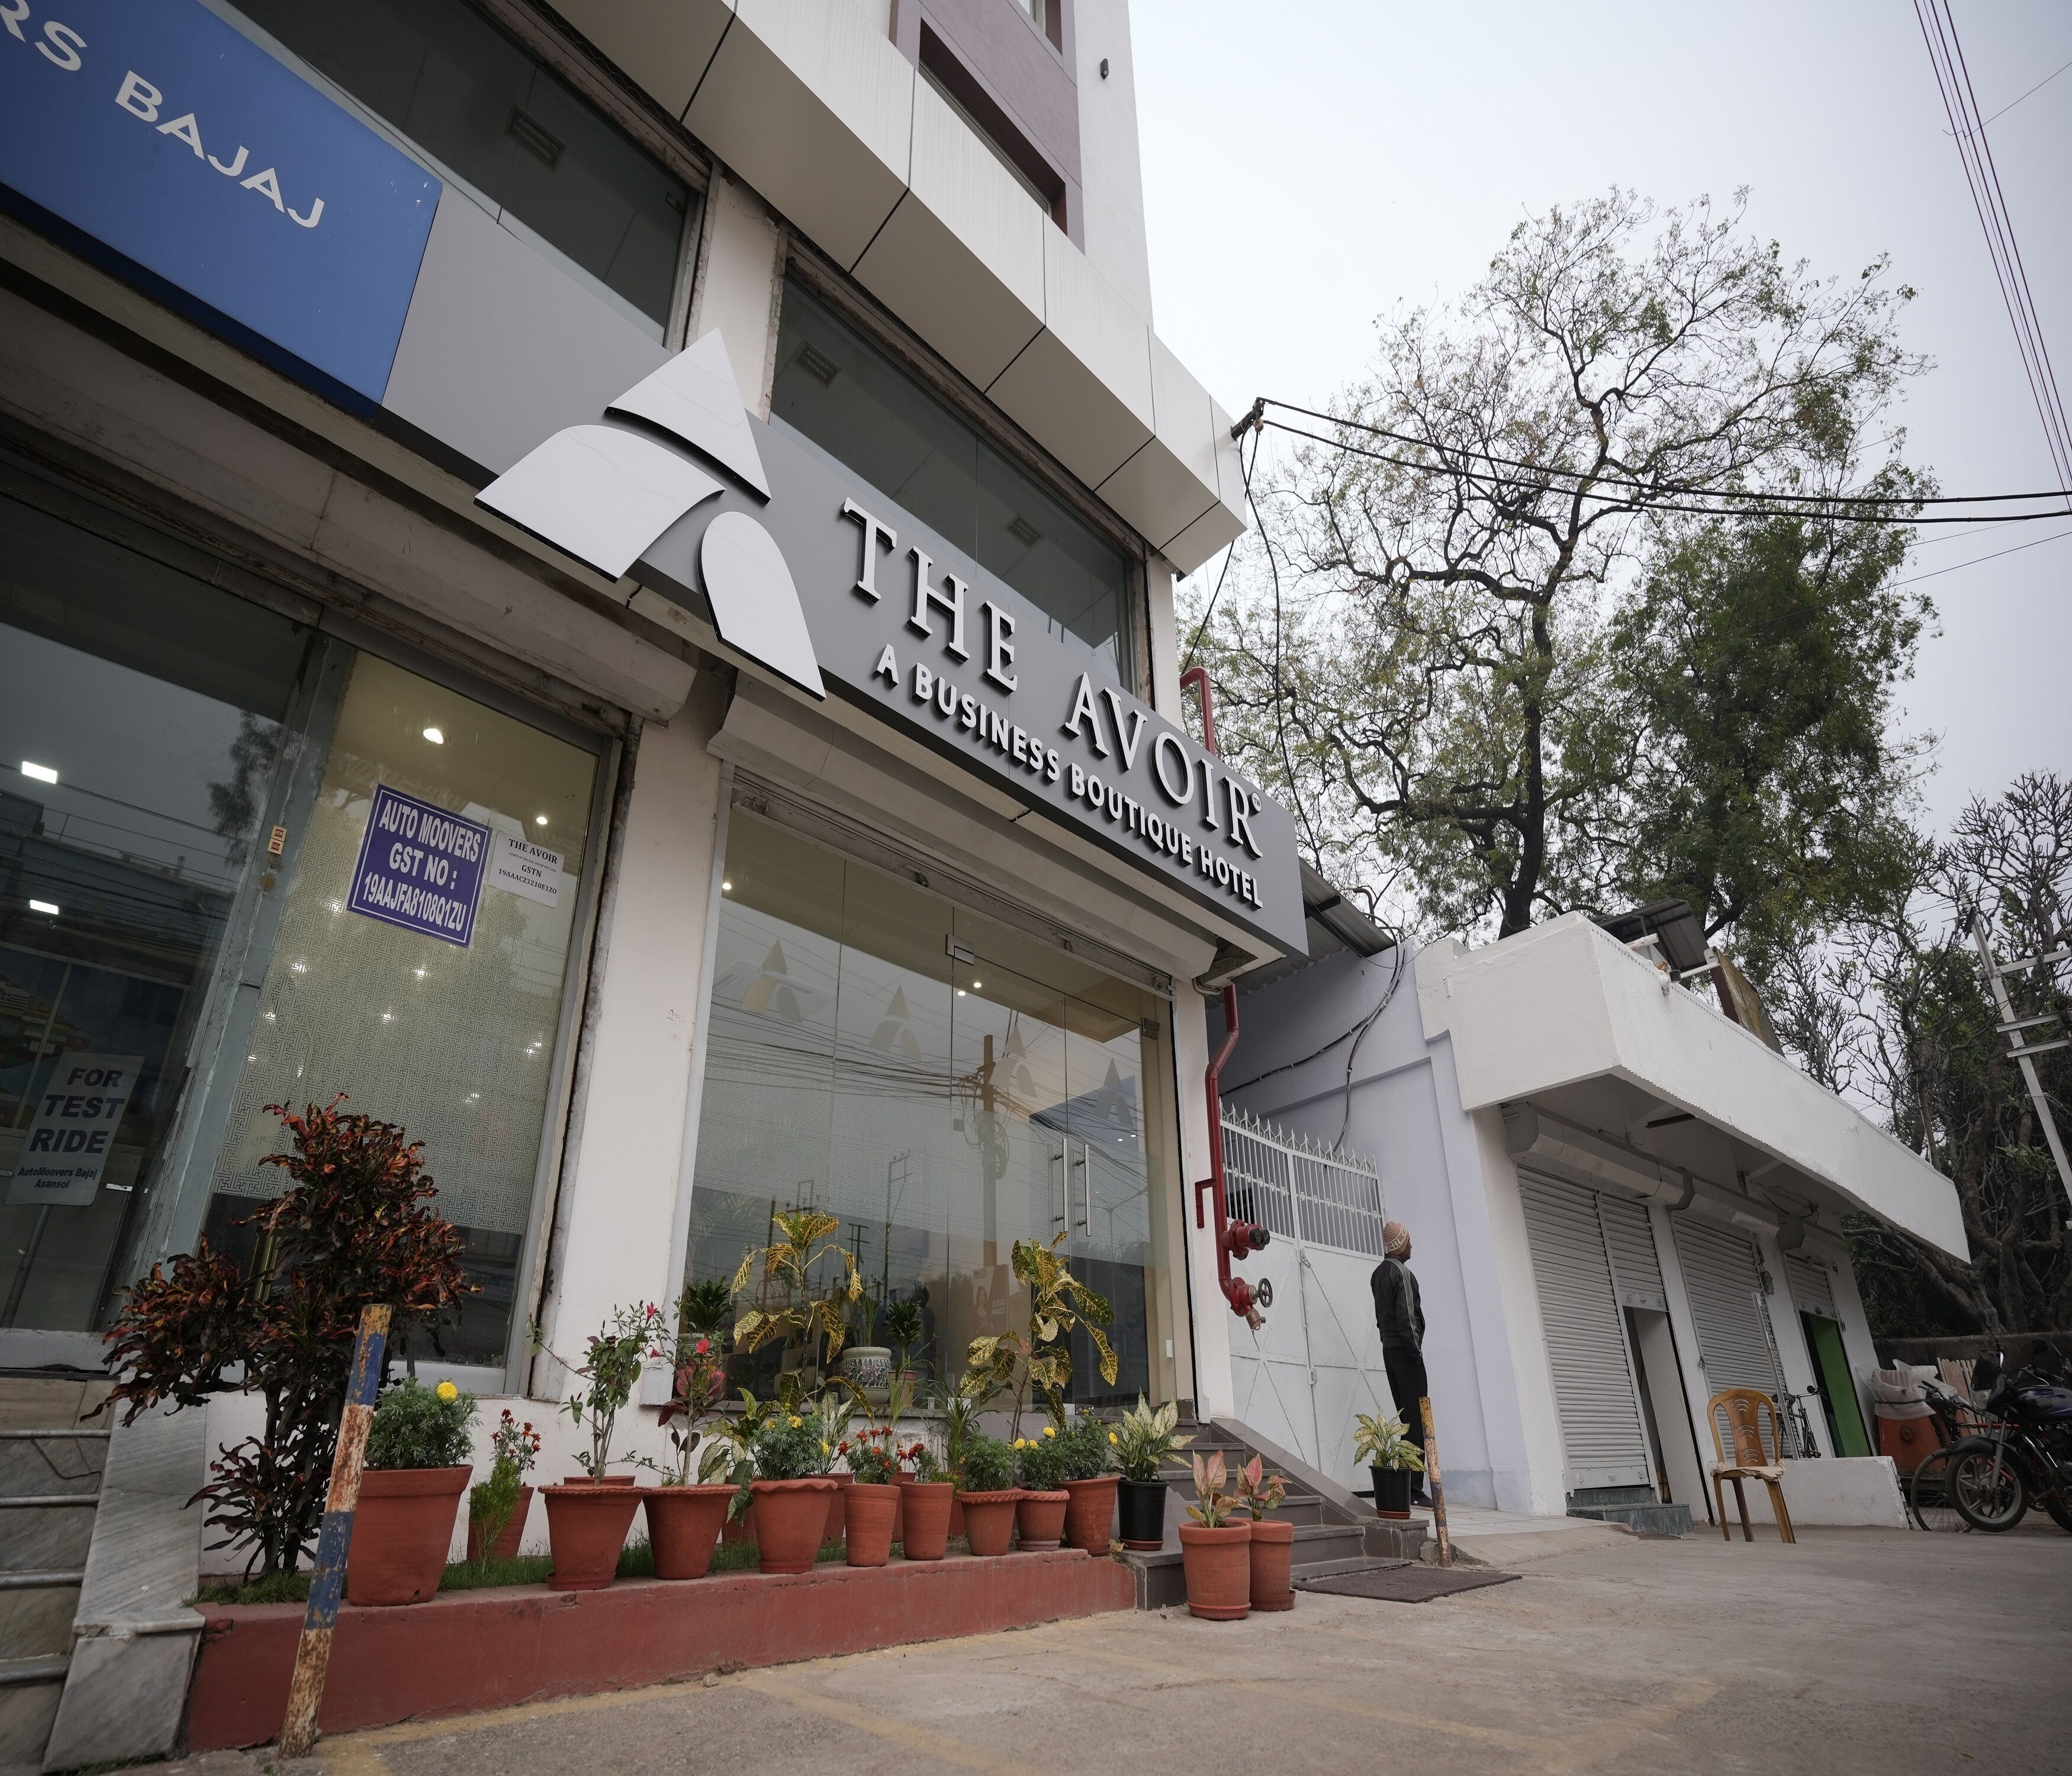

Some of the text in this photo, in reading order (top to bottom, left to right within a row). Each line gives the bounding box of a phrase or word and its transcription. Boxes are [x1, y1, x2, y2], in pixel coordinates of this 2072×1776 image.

[114, 70, 325, 228] BAJAJ
[840, 497, 1018, 694] THE
[1061, 671, 1263, 859] AVOIR
[873, 643, 1263, 910] A BUSINESS BOUTIQUE HOTEL
[379, 799, 481, 863] AUTO MOOVERS
[389, 842, 424, 877] GST
[509, 838, 558, 865] THE AVOIR
[522, 864, 542, 878] GSTN
[363, 871, 467, 932] 19AAJFA8108Q1ZU
[66, 1067, 123, 1088] FOR
[44, 1093, 126, 1119] TEST
[28, 1128, 110, 1154] RIDE
[17, 1167, 98, 1180] AutoMoovers Bajaj
[34, 1179, 70, 1189] Asansol
